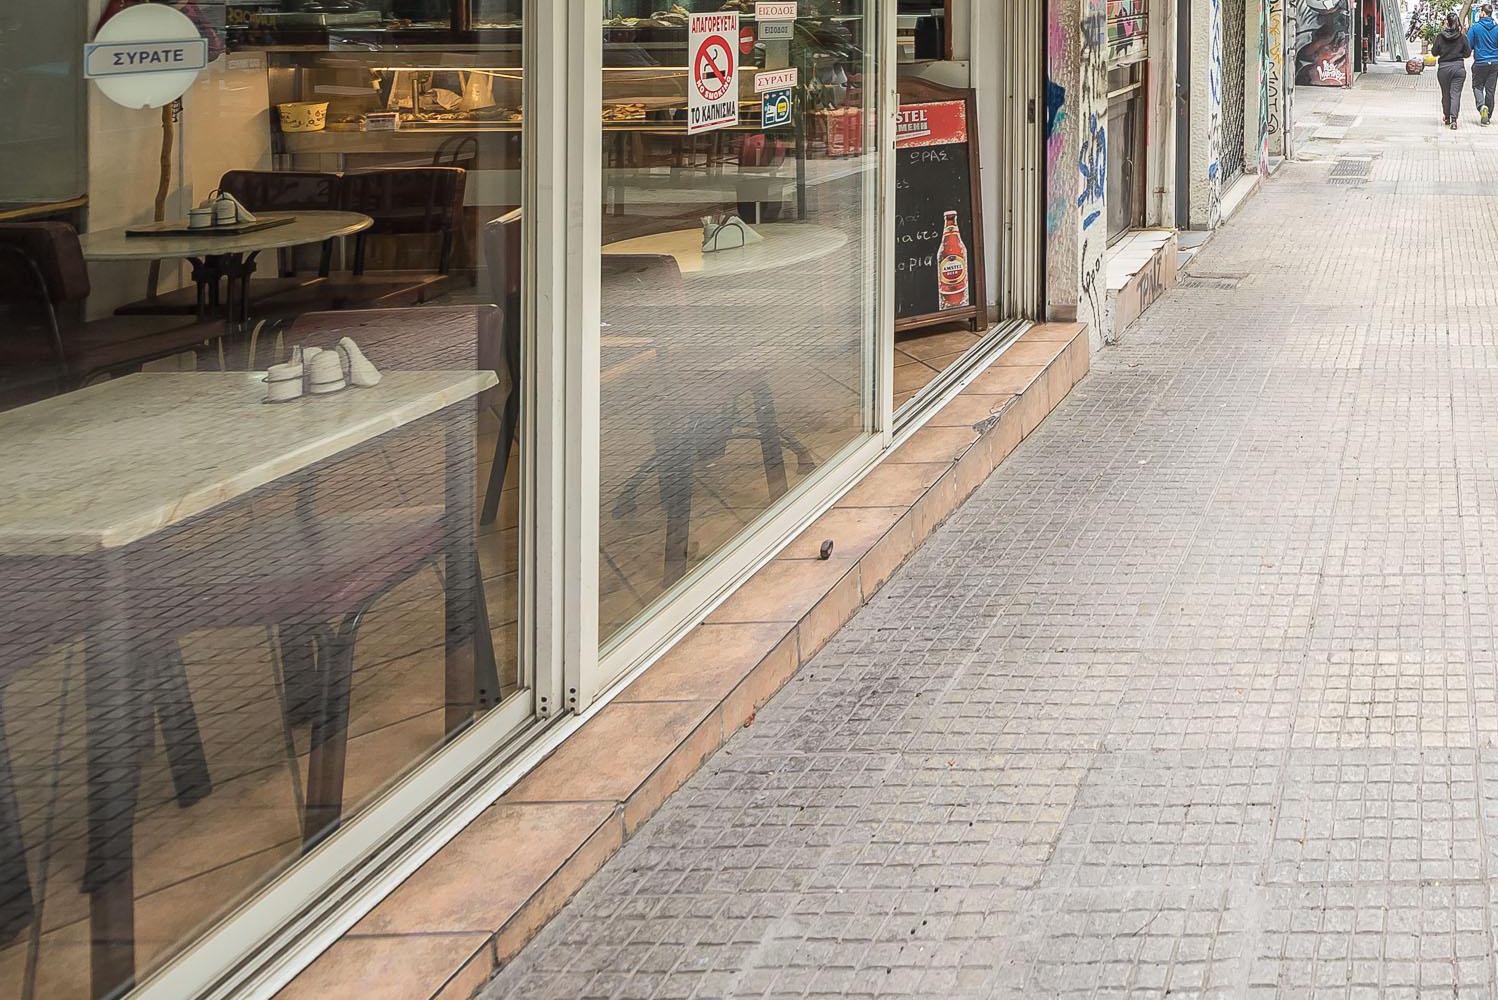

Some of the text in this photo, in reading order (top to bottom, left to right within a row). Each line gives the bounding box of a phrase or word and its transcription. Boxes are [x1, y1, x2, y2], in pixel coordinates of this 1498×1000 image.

[758, 6, 795, 16] ΕΙΣΟΔΟΣ
[691, 15, 737, 33] ΑΠΑΓΟΡΕΥΕΤΑΙ
[764, 25, 789, 34] ΕΙΣΟΔΟΣ
[113, 48, 185, 66] ΣΥΡΑΤΕ
[696, 75, 732, 100] NO SMOKING
[757, 73, 795, 87] ΣΥΡΑΤΕ
[691, 101, 736, 124] ΤΟ ΚΑΠΝΙΣΜΑ
[943, 264, 963, 272] AMSTEL
